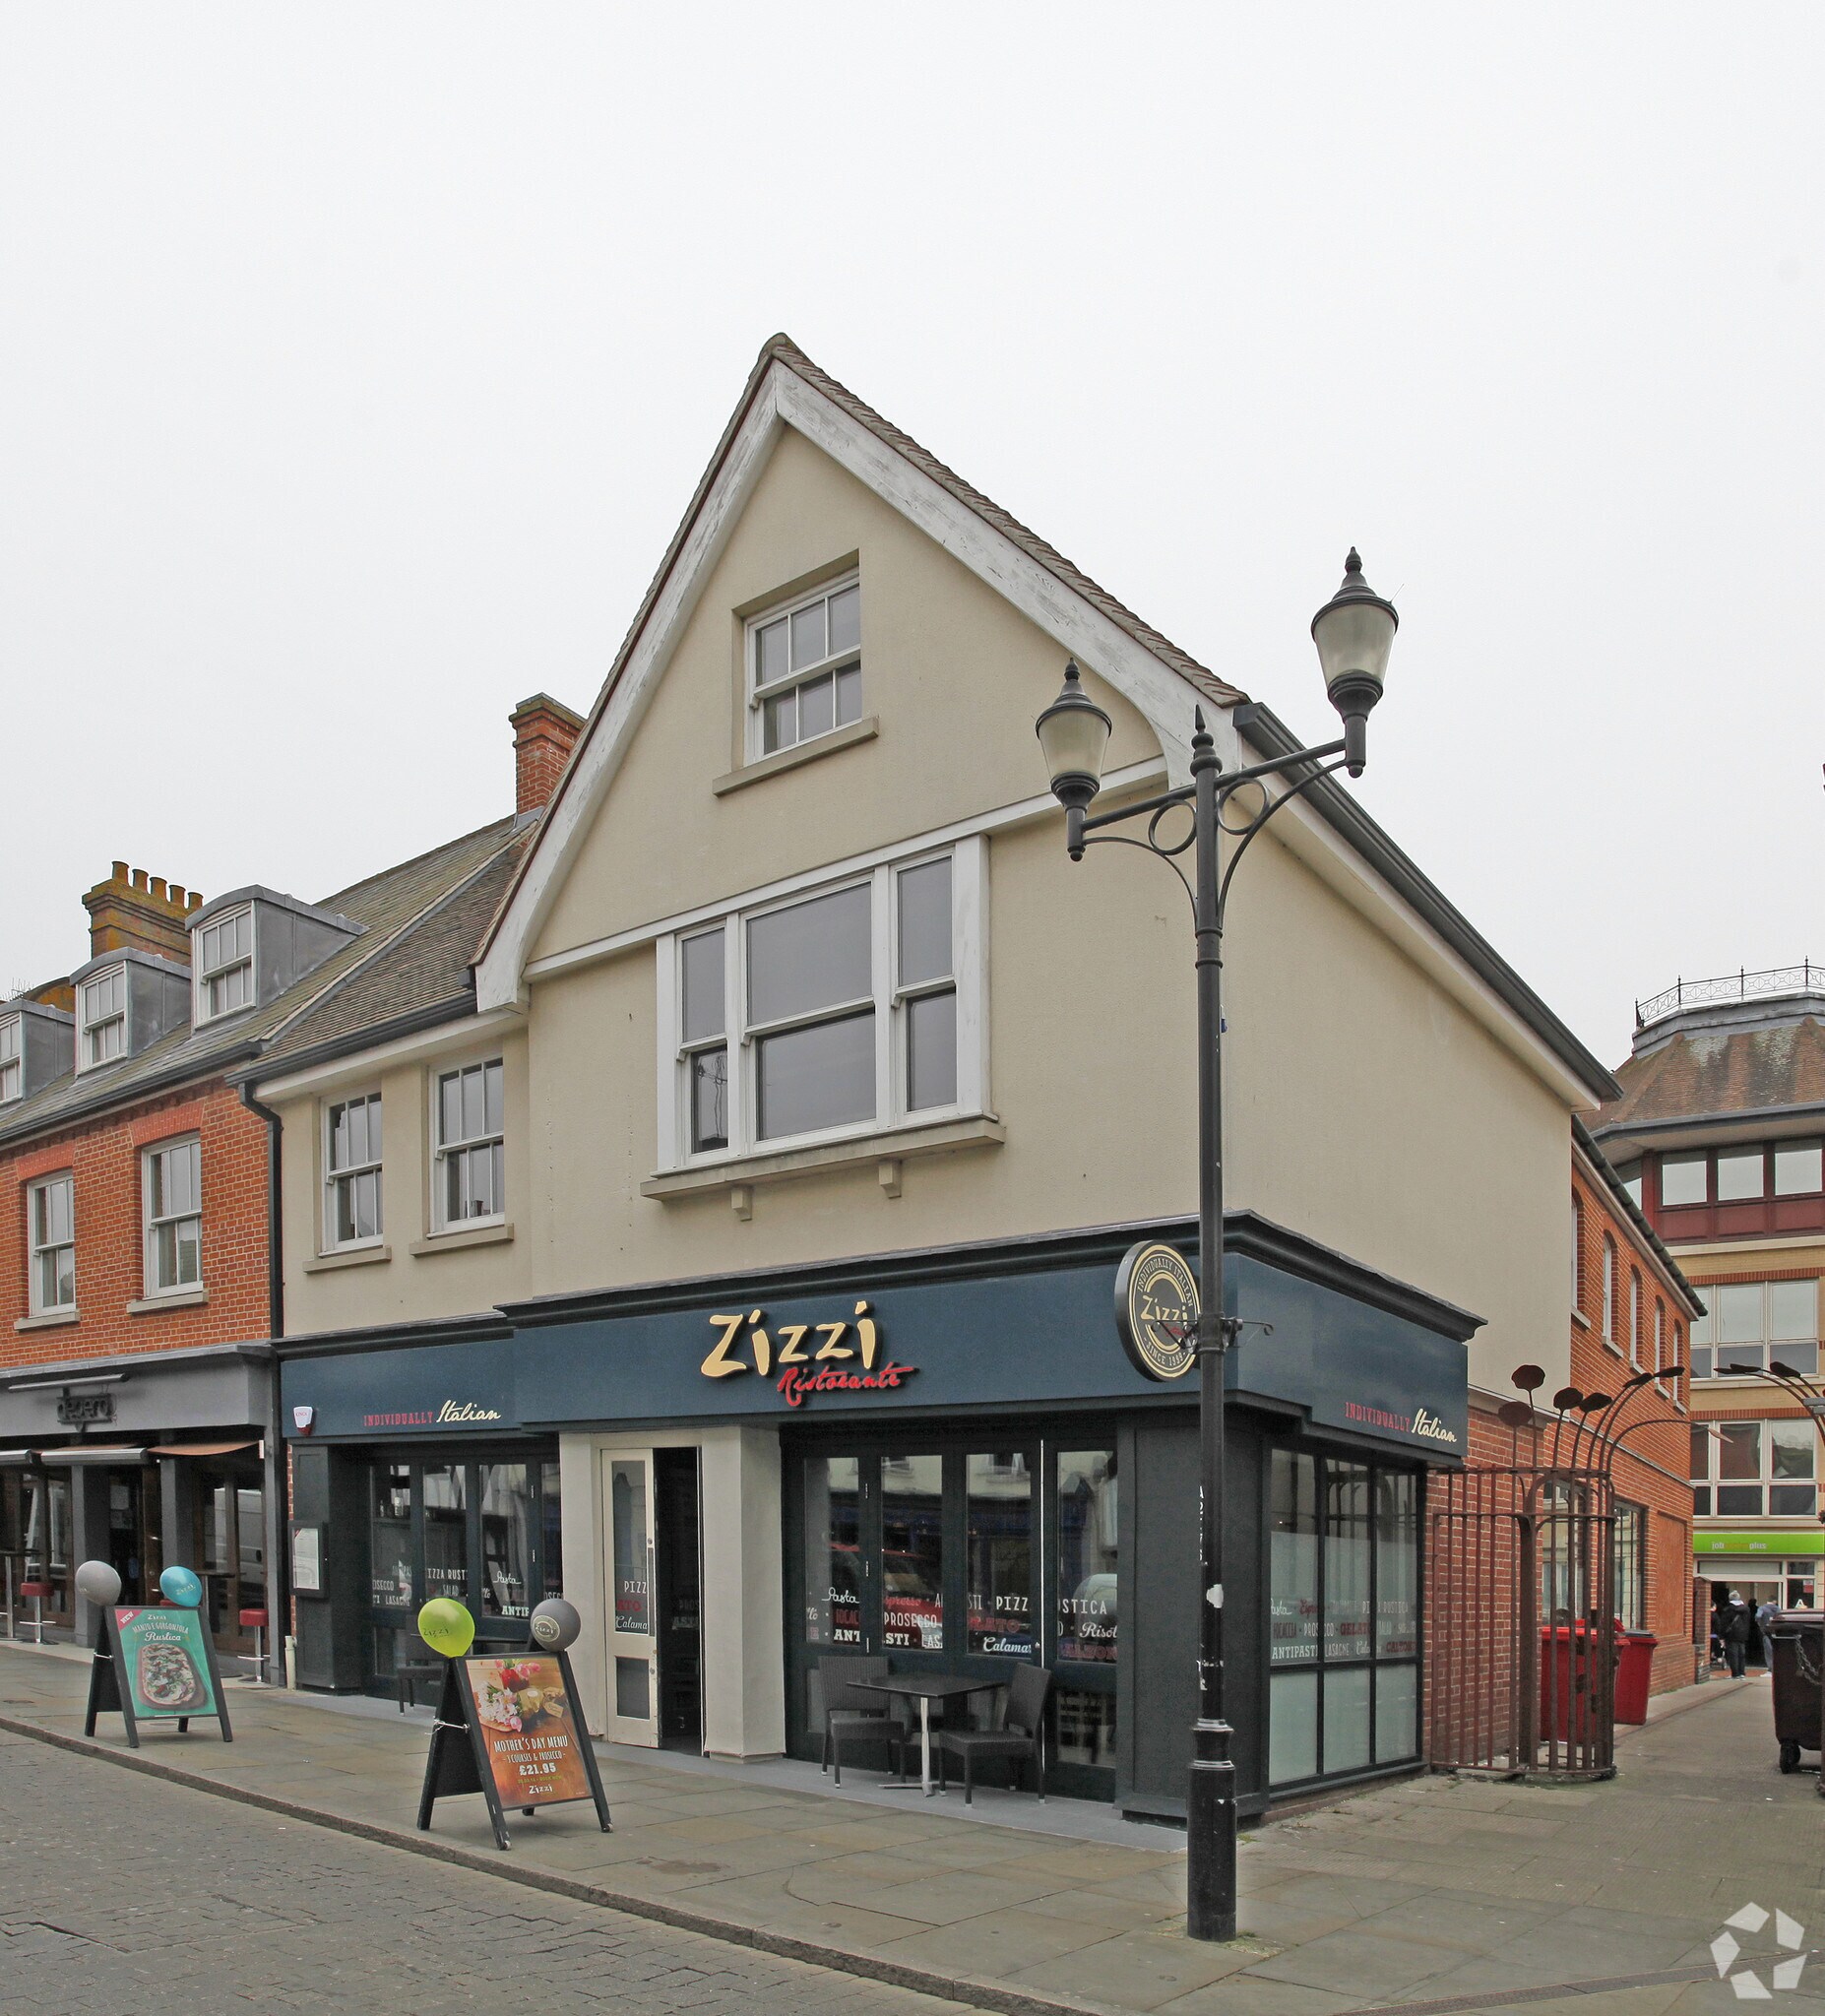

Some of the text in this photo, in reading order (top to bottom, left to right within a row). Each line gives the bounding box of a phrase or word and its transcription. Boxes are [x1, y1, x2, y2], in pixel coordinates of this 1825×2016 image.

[1137, 1258, 1194, 1307] INDIVIDUALLY ITALIAN
[1140, 1293, 1188, 1327] Zizzi
[701, 1300, 876, 1377] Zizzi
[1145, 1342, 1166, 1365] SINCE
[777, 1361, 914, 1407] Ristorante
[363, 1400, 501, 1426] INDIVIDUALLY Italian
[1345, 1402, 1458, 1443] INDIVIDUALLY Italian
[492, 1570, 522, 1585] Pasta
[821, 1587, 860, 1604] Pasta
[120, 1610, 135, 1624] NEW
[144, 1632, 182, 1642] Rustica
[423, 1625, 451, 1638] Zizzi
[493, 1735, 568, 1752] MOTHER'S DAY MENU
[512, 1753, 532, 1763] COURSES
[539, 1750, 562, 1761] PROSECCO
[519, 1762, 556, 1776] £21.95
[529, 1784, 553, 1795] Zizzi
